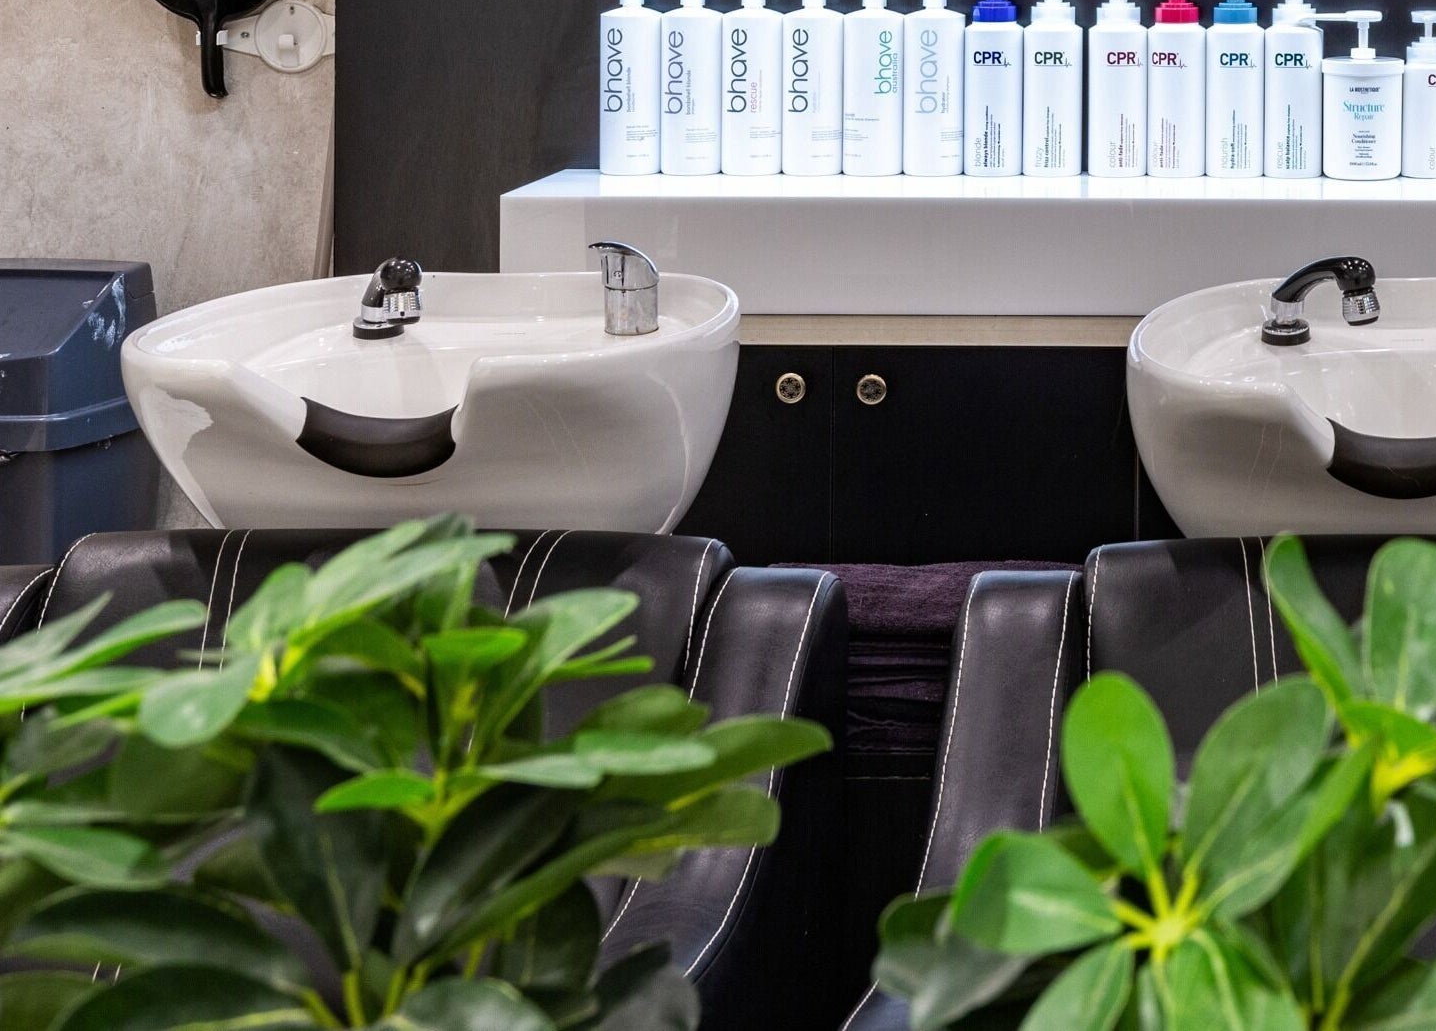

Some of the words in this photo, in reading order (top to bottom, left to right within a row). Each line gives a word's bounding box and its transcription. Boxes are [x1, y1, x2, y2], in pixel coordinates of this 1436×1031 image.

[604, 28, 623, 113] bhave
[664, 30, 684, 115] bhave
[727, 28, 747, 113] bhave
[788, 28, 808, 113] bhave
[874, 30, 892, 94] bhave
[891, 52, 899, 93] australia
[915, 29, 938, 114] bhave
[973, 51, 1003, 65] CPR
[1034, 51, 1064, 65] CPR
[1107, 52, 1137, 65] CPR
[1152, 52, 1178, 66] CPR
[1220, 53, 1249, 66] CPR
[1275, 53, 1304, 66] CPR
[749, 82, 758, 113] rescue
[1343, 100, 1385, 113] Structure
[974, 137, 982, 168] blonde
